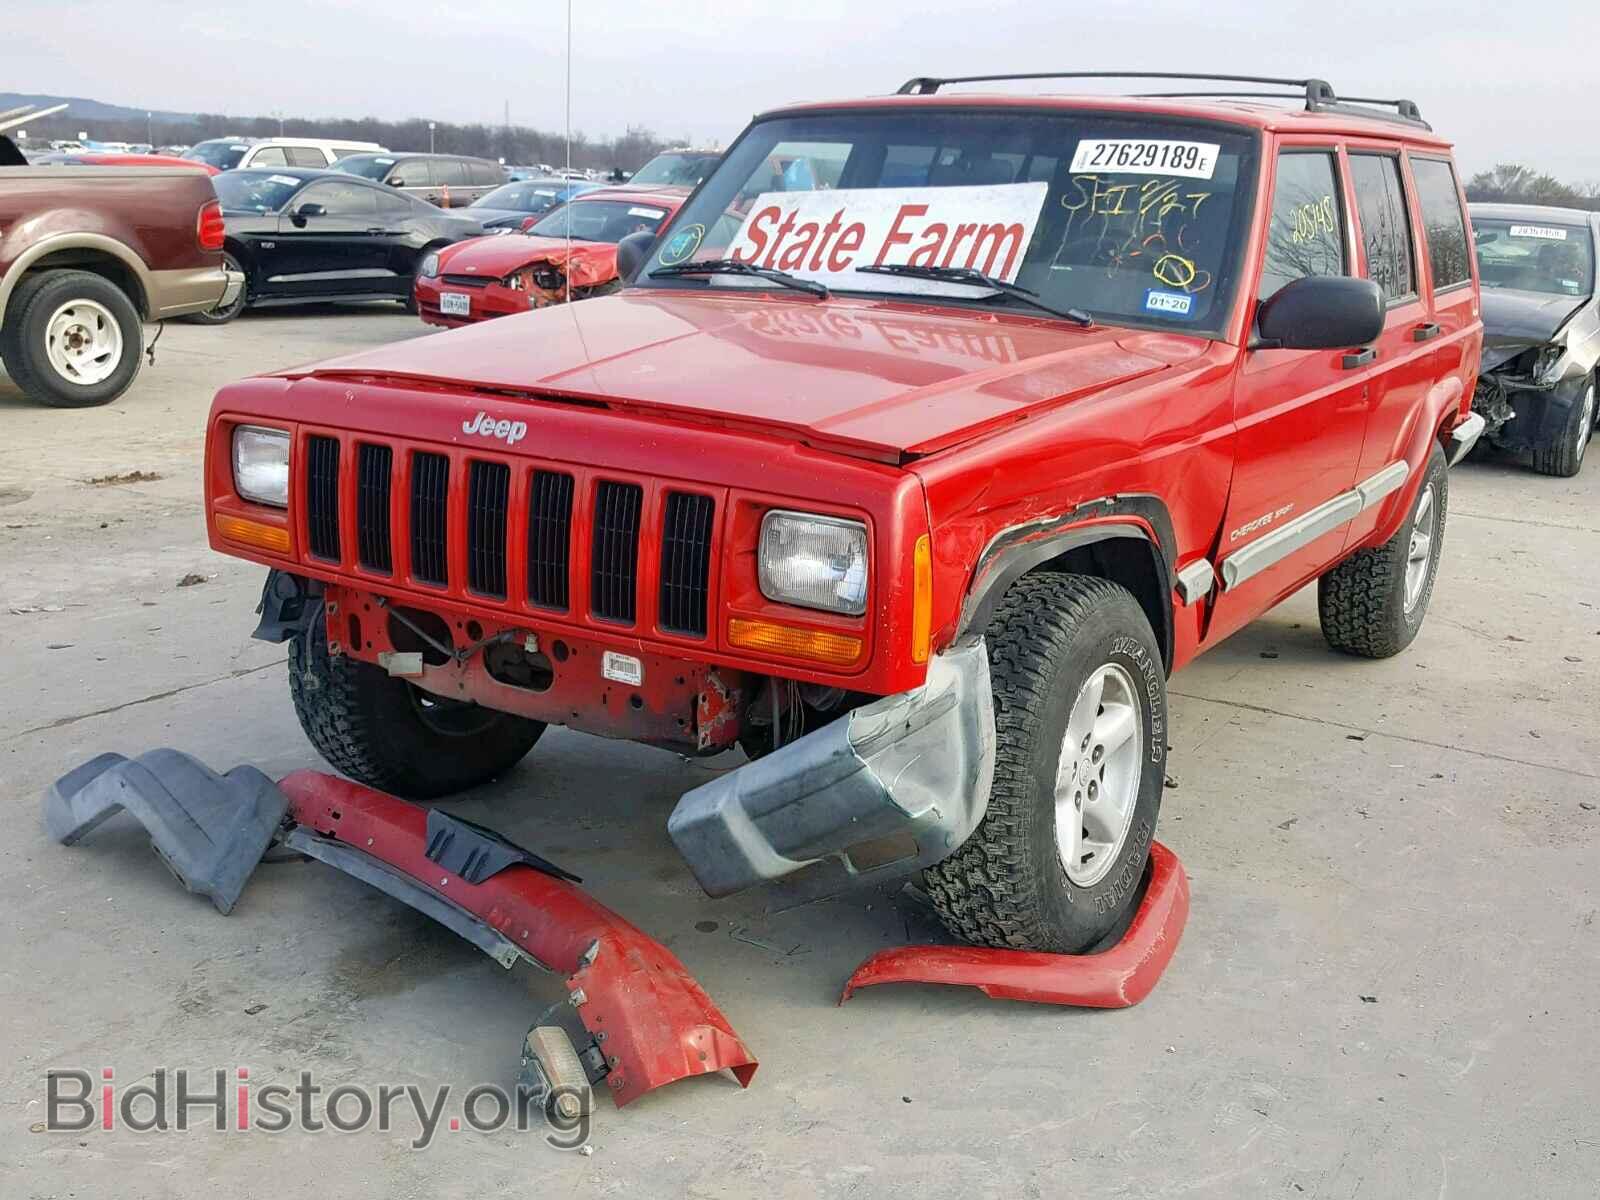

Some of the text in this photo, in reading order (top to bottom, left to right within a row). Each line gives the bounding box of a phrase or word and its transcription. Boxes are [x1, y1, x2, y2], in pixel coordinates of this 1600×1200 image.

[732, 204, 1025, 281] State Farm
[462, 411, 527, 445] Jeep
[1109, 636, 1163, 763] WRANGLER
